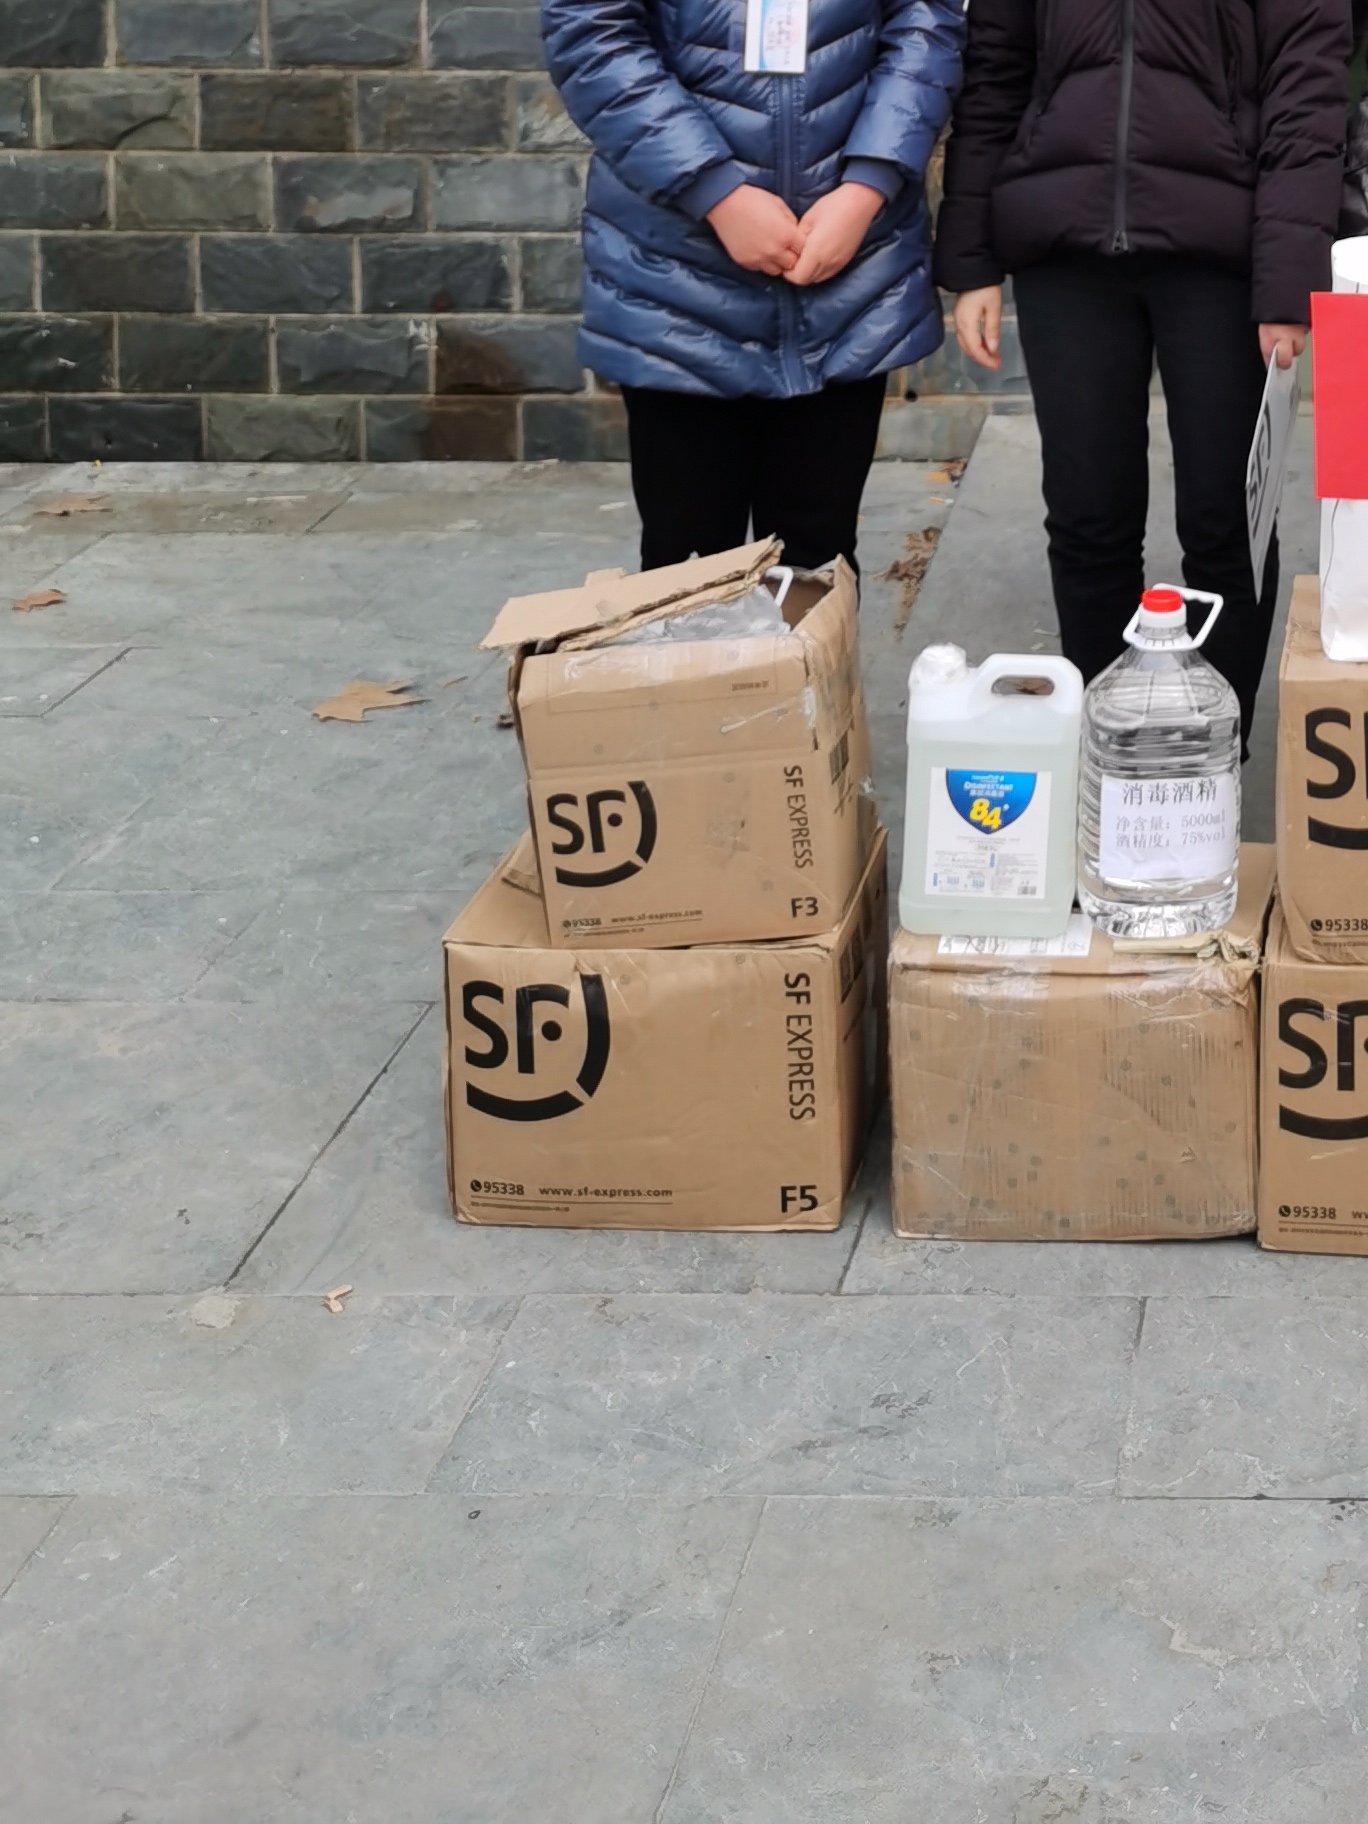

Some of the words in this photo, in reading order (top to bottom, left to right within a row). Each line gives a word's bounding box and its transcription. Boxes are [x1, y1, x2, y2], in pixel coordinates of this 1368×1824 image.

[783, 765, 803, 788] SF
[1122, 778, 1217, 805] 消毒酒精
[546, 788, 626, 855] SF
[970, 798, 1001, 829] 84
[787, 793, 814, 869] EXPRESS
[791, 897, 819, 918] F3
[1325, 919, 1368, 931] 95338
[783, 972, 811, 1006] SF
[462, 981, 570, 1075] SF
[786, 1015, 816, 1121] EXPRESS
[483, 1181, 525, 1195] 95338
[539, 1185, 673, 1198] www.sf-express.com
[780, 1184, 818, 1213] F5
[1293, 1206, 1337, 1219] 95338
